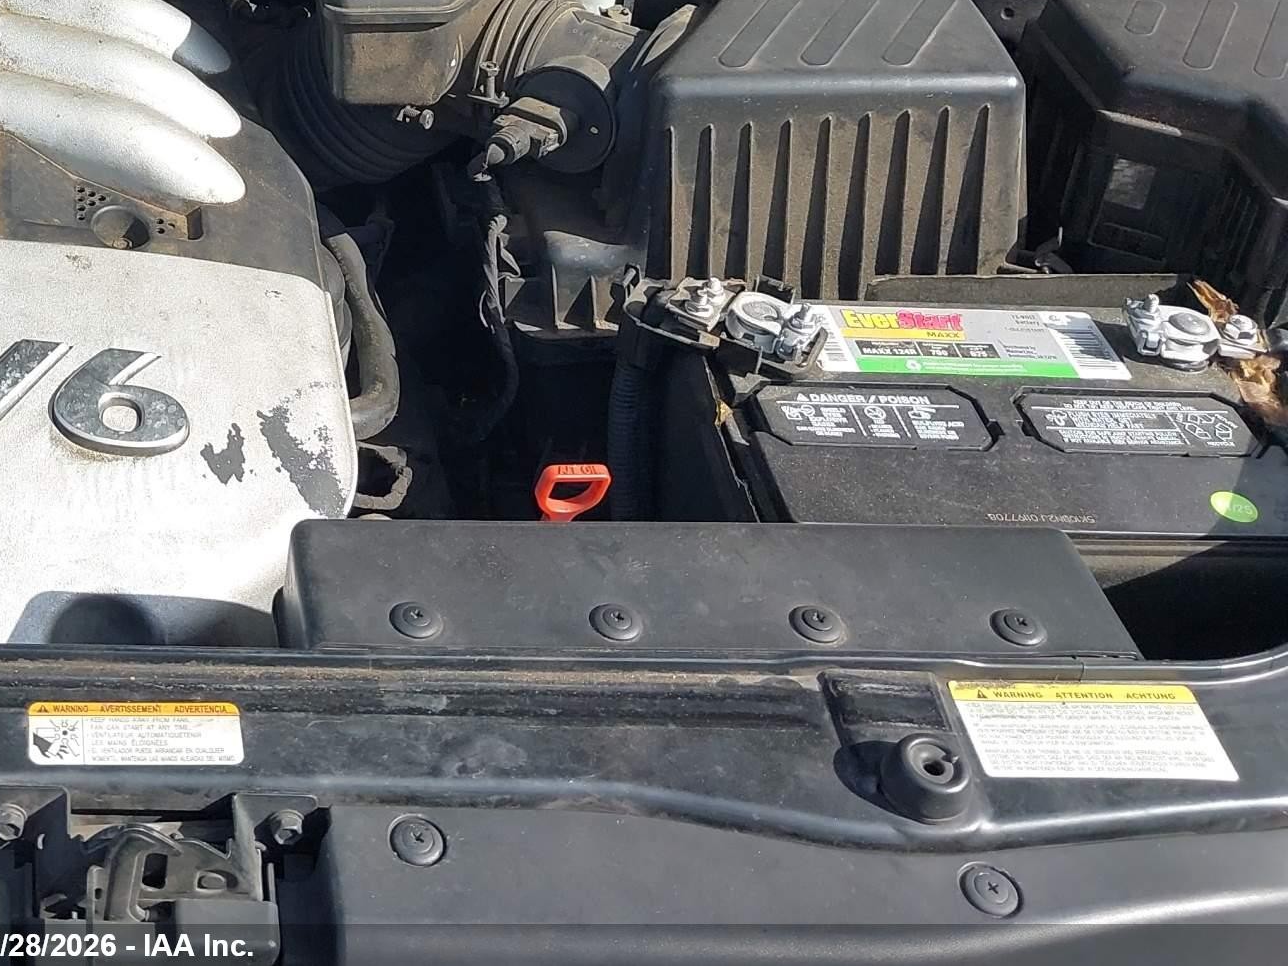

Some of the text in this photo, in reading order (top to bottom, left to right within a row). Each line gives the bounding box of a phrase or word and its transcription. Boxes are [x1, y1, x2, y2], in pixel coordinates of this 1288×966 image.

[840, 309, 964, 331] EverStart
[862, 347, 892, 355] MAXX
[809, 393, 865, 403] DANGER
[879, 395, 931, 405] POISON
[1055, 691, 1113, 699] ATTENTION
[1126, 692, 1176, 700] ACHTUNG
[53, 705, 227, 713] WARNING AVERTISSEMENT ADVERTENCIA
